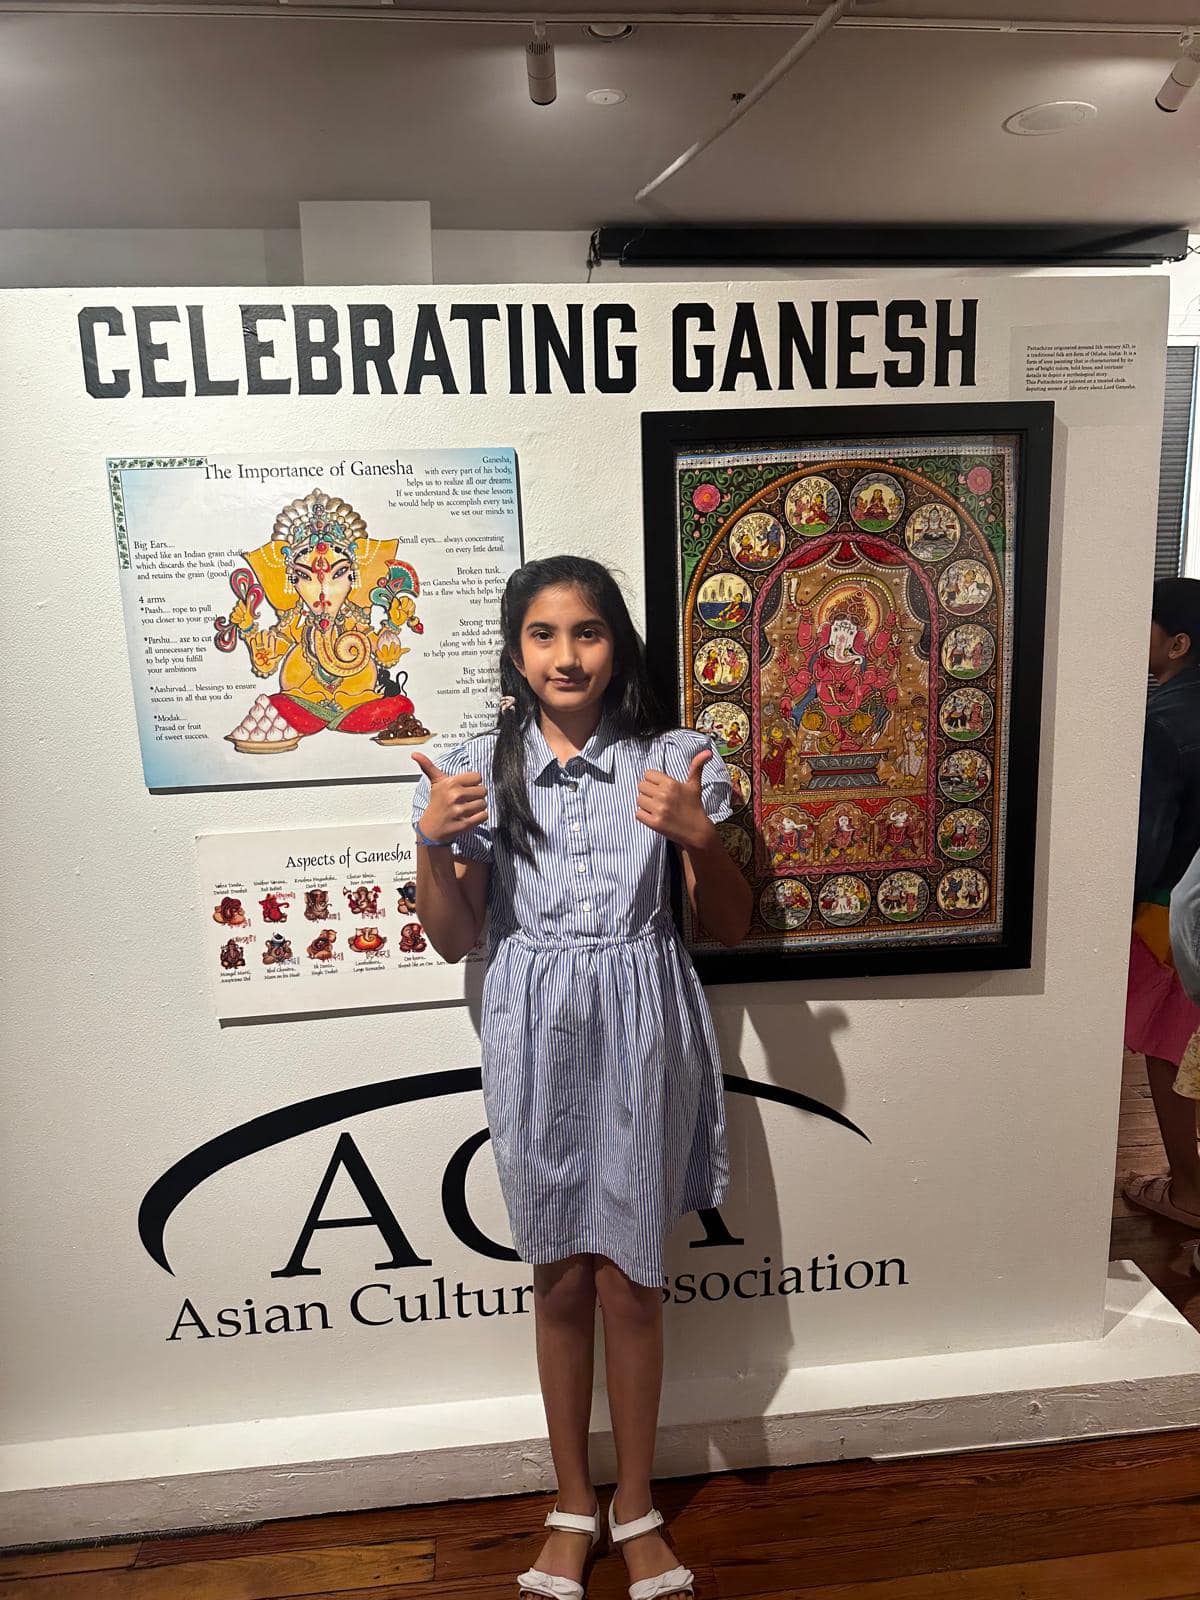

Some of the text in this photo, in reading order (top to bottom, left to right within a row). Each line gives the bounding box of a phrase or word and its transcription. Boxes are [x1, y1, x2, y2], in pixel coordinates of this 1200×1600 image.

[78, 299, 979, 398] CELEBRATING GANESH
[204, 459, 414, 483] The Importance of Ganesha
[134, 541, 147, 551] Big
[457, 567, 482, 575] Broken
[463, 667, 475, 676] Big
[286, 844, 411, 871] Aspects of Ganesha
[166, 1298, 333, 1341] Asian
[350, 1276, 534, 1327] Cultur
